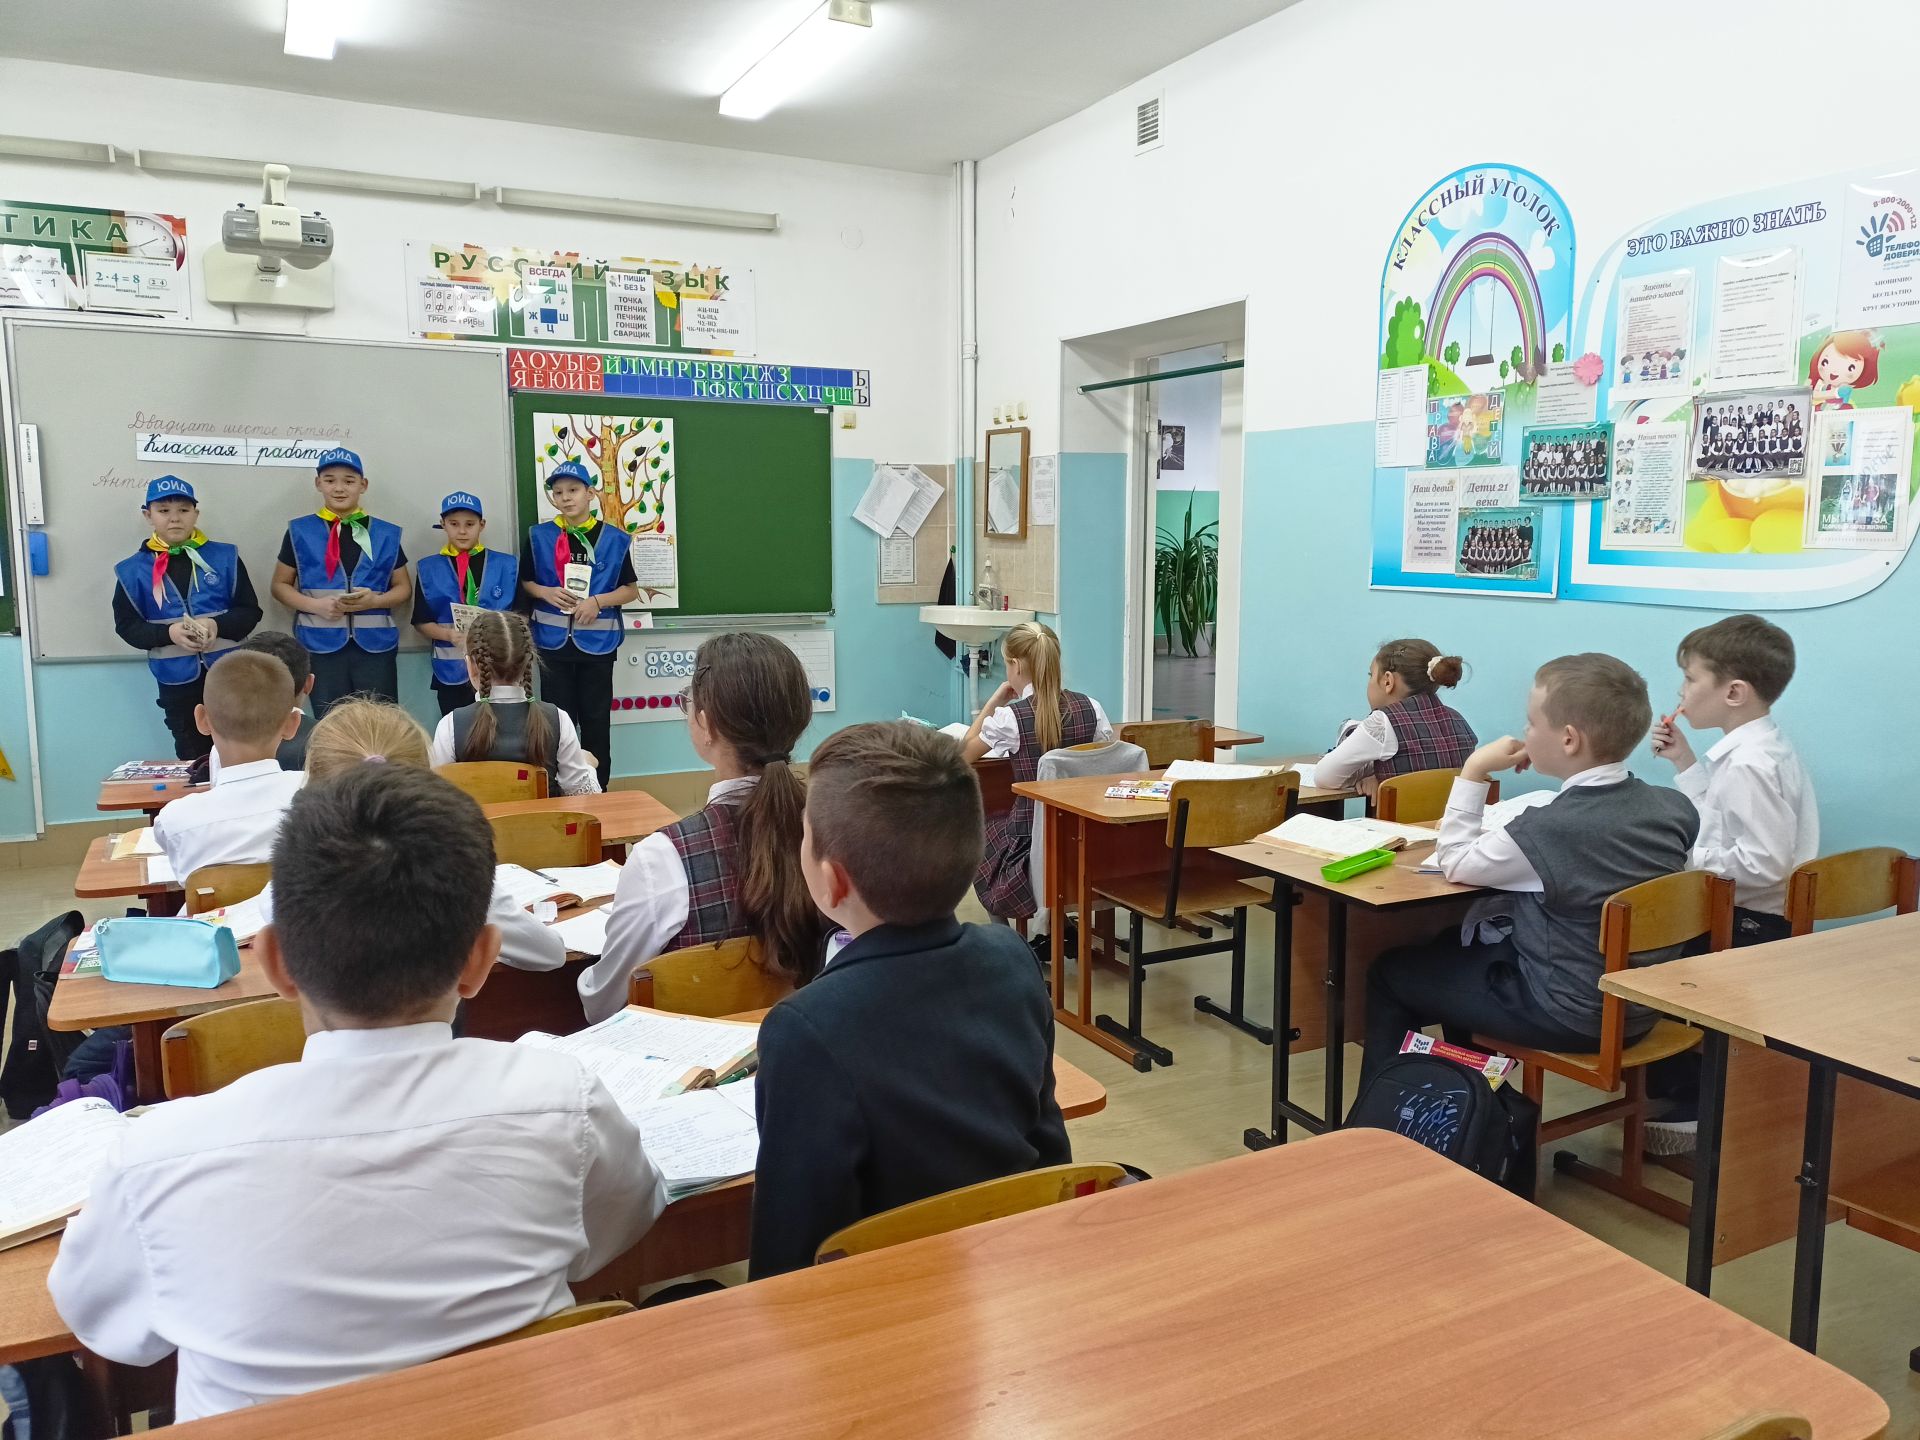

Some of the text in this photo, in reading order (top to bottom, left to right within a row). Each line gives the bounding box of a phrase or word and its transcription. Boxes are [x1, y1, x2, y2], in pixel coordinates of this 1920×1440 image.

[1393, 174, 1561, 271] КЛАССНЫЙ УГОЛОК
[1627, 201, 1827, 257] ЭТО ВАЖНО ЗНАТЬ
[1884, 250, 1920, 262] ДОВЕРИ
[529, 267, 566, 278] ВСЕГДА
[624, 275, 646, 283] ПИШИ
[624, 284, 638, 292] БЕЗ
[618, 296, 642, 304] ТОЧКА
[614, 304, 648, 313] ПТЕНЧИК
[616, 313, 646, 321] ПЕЧНИК
[616, 321, 647, 330] ГОНЩИК
[613, 329, 650, 339] СВАРЩИК
[127, 410, 216, 434] Двадцать
[223, 422, 278, 436] шестое
[144, 433, 238, 457] Классная
[324, 450, 353, 463] ЮИД
[157, 478, 189, 495] ЮИД
[1413, 485, 1430, 493] Наш
[1466, 483, 1509, 494] Дети 21
[447, 494, 475, 506] ЮИД
[1475, 498, 1499, 507] века
